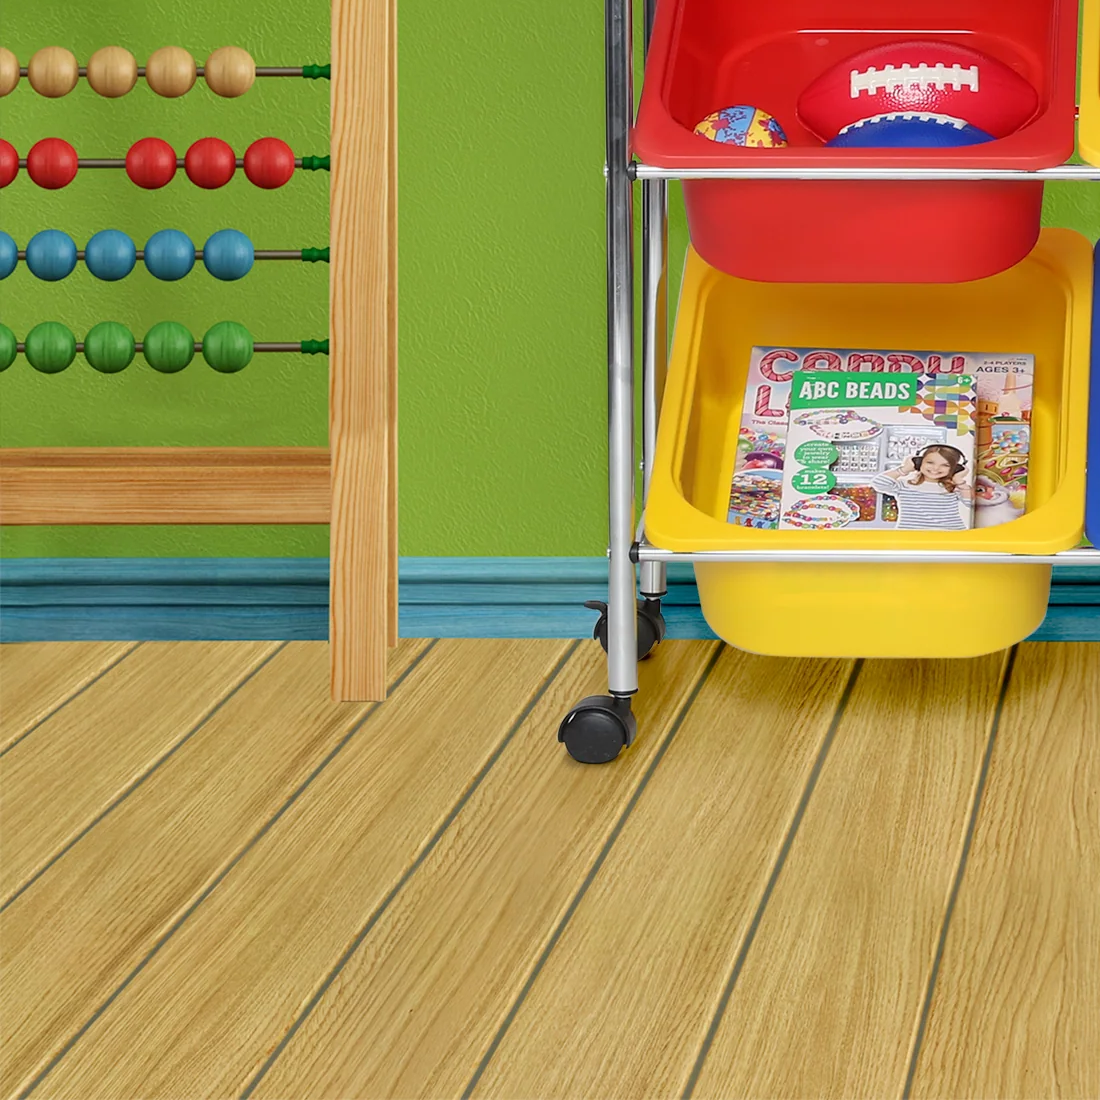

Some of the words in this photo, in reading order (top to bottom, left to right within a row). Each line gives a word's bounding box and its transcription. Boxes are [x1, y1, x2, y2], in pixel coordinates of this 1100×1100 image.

[957, 376, 971, 384] 6+
[799, 381, 840, 400] ABC
[845, 381, 911, 400] BEADS
[800, 474, 828, 485] 12
